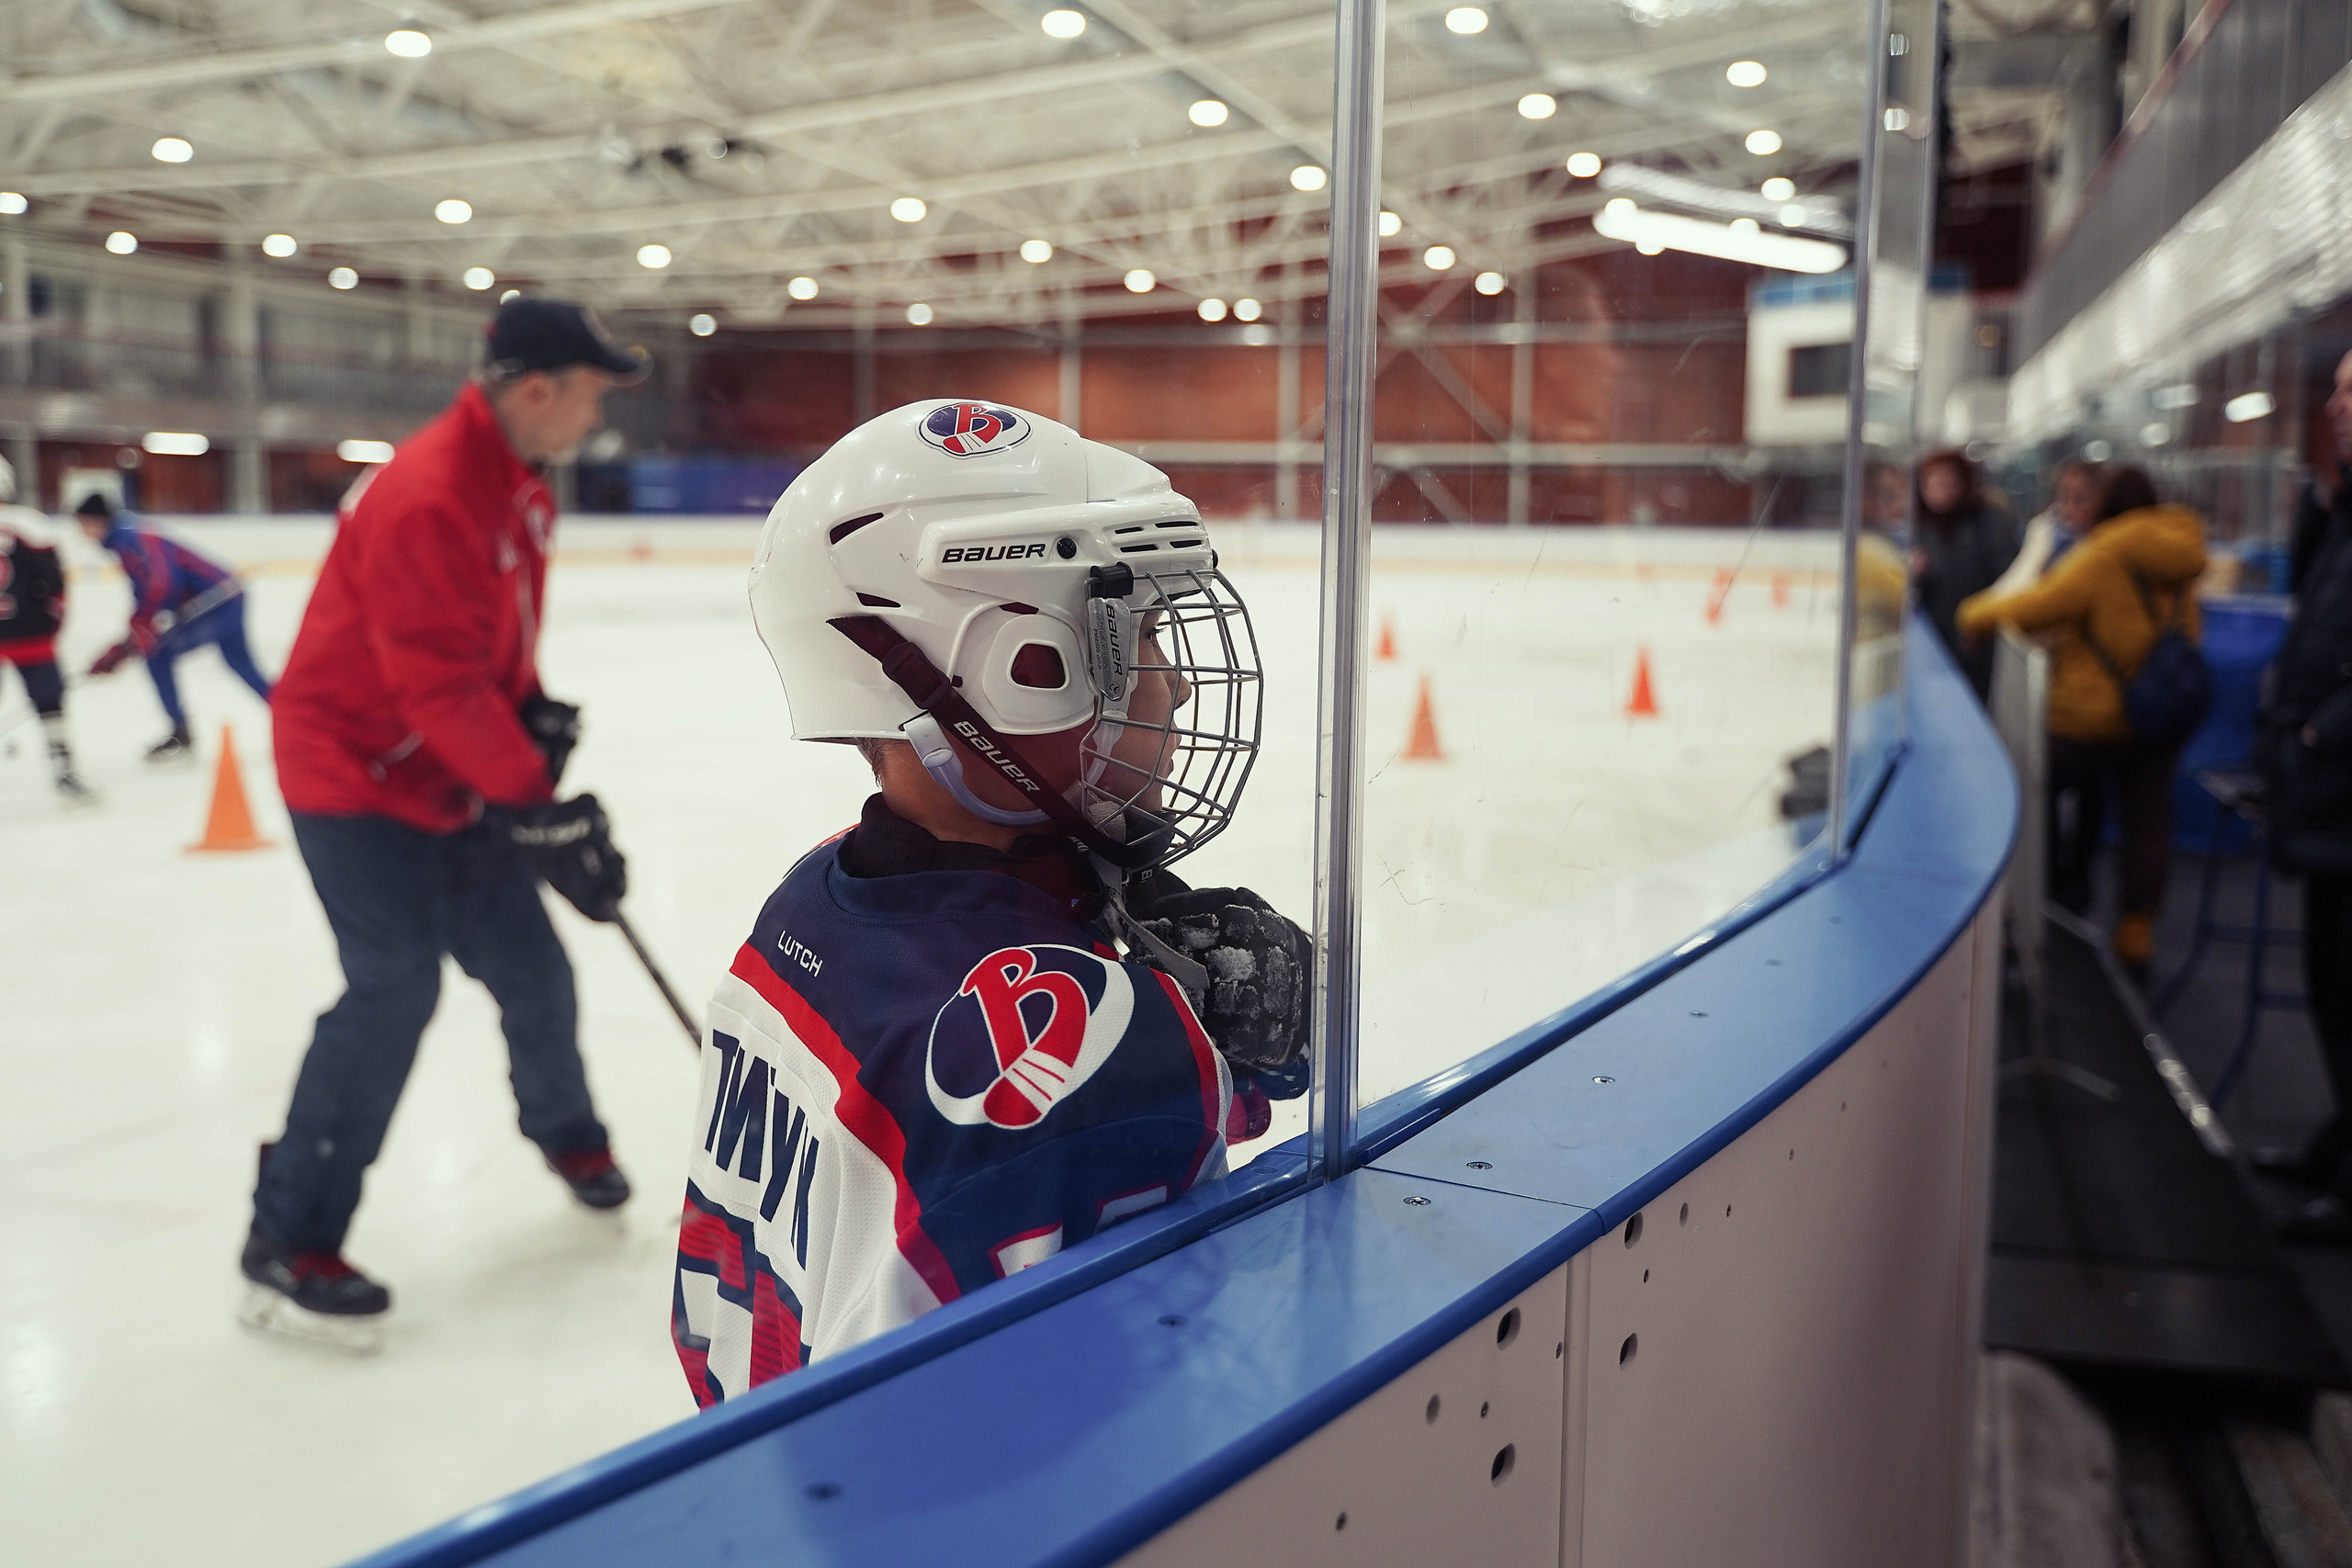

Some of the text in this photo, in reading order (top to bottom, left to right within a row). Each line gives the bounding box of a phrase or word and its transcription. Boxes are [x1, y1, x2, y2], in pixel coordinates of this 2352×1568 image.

[941, 543, 1046, 563] BAUER
[1105, 604, 1123, 676] BAUER
[953, 720, 1041, 792] BAUER
[777, 930, 824, 977] LUTCH
